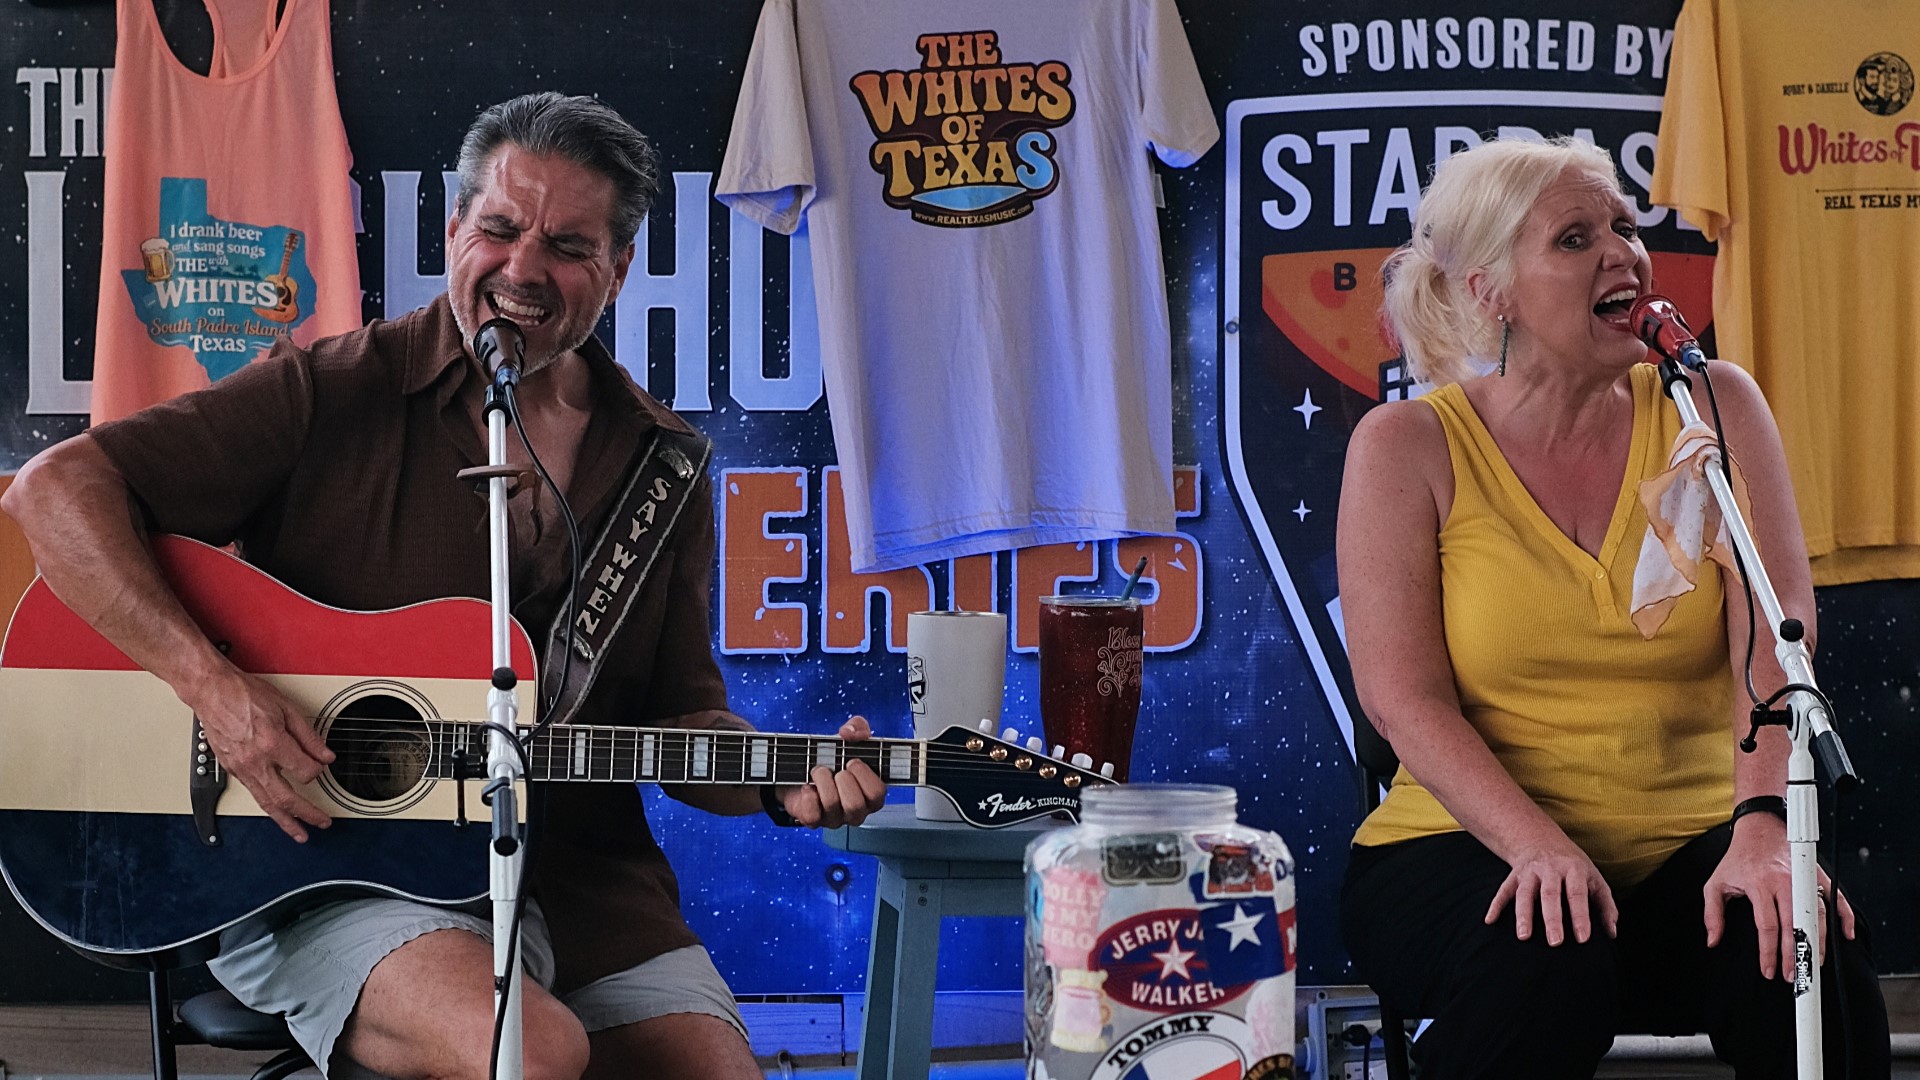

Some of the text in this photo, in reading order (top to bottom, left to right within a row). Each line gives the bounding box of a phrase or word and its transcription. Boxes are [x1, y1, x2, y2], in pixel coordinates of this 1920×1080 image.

[919, 33, 998, 68] THE
[1299, 17, 1675, 79] SPONSORED BY
[853, 62, 1072, 133] WHITES
[941, 114, 985, 144] OF
[1778, 122, 1889, 176] Whites
[874, 131, 1054, 198] TEXAS
[914, 204, 1032, 225] www.REALTEXASMUSIC.com
[1824, 195, 1856, 210] REAL
[1859, 194, 1902, 208] TEXAS
[170, 222, 263, 242] I drank beer
[171, 240, 266, 260] and sang songs
[176, 258, 208, 273] THE
[153, 277, 278, 310] WHITES
[207, 306, 225, 317] on
[150, 317, 289, 338] South Padre Island
[189, 334, 246, 353] Texas
[575, 477, 672, 636] SAY WHEN
[986, 793, 1079, 818] Fender KINGMAN
[1112, 919, 1181, 960] JERRY
[1108, 1015, 1216, 1069] TOMMY
